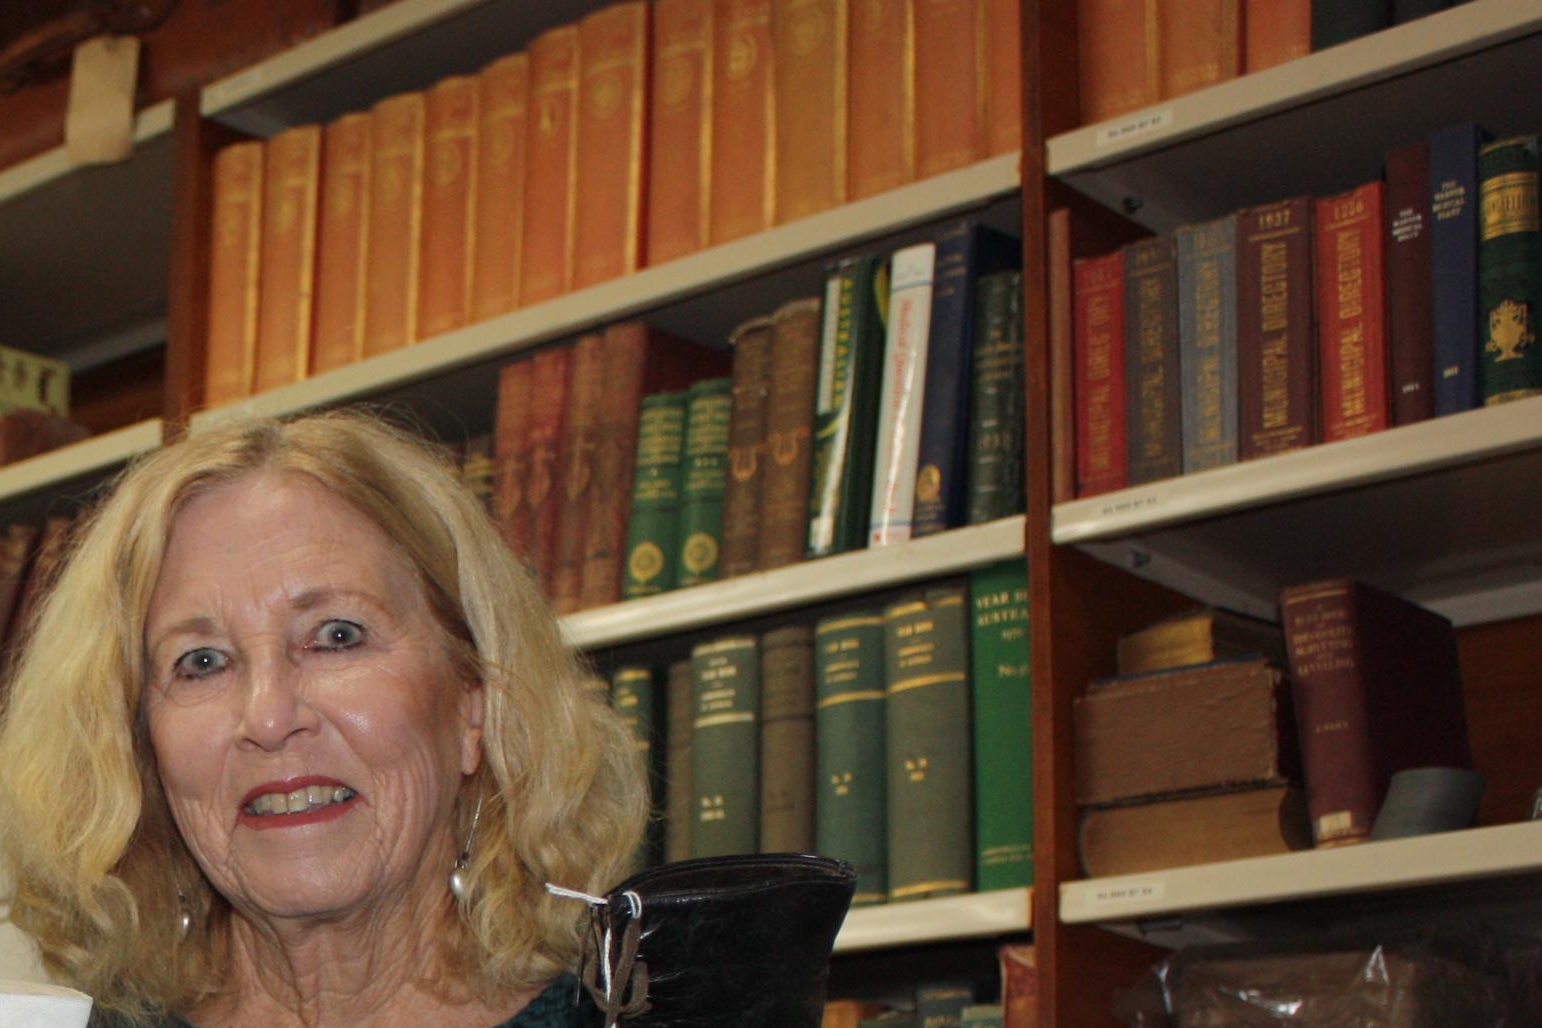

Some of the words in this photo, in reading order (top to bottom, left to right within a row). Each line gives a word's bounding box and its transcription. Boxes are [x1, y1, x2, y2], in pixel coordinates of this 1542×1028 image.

[1258, 210, 1291, 229] 1937
[1261, 241, 1288, 332] DIRECTORY
[1337, 231, 1363, 320] DIRECTORY
[1262, 334, 1288, 429] MUNICIPAL
[1340, 322, 1364, 418] MUNICIPAL
[977, 607, 1029, 626] AUSTRA
